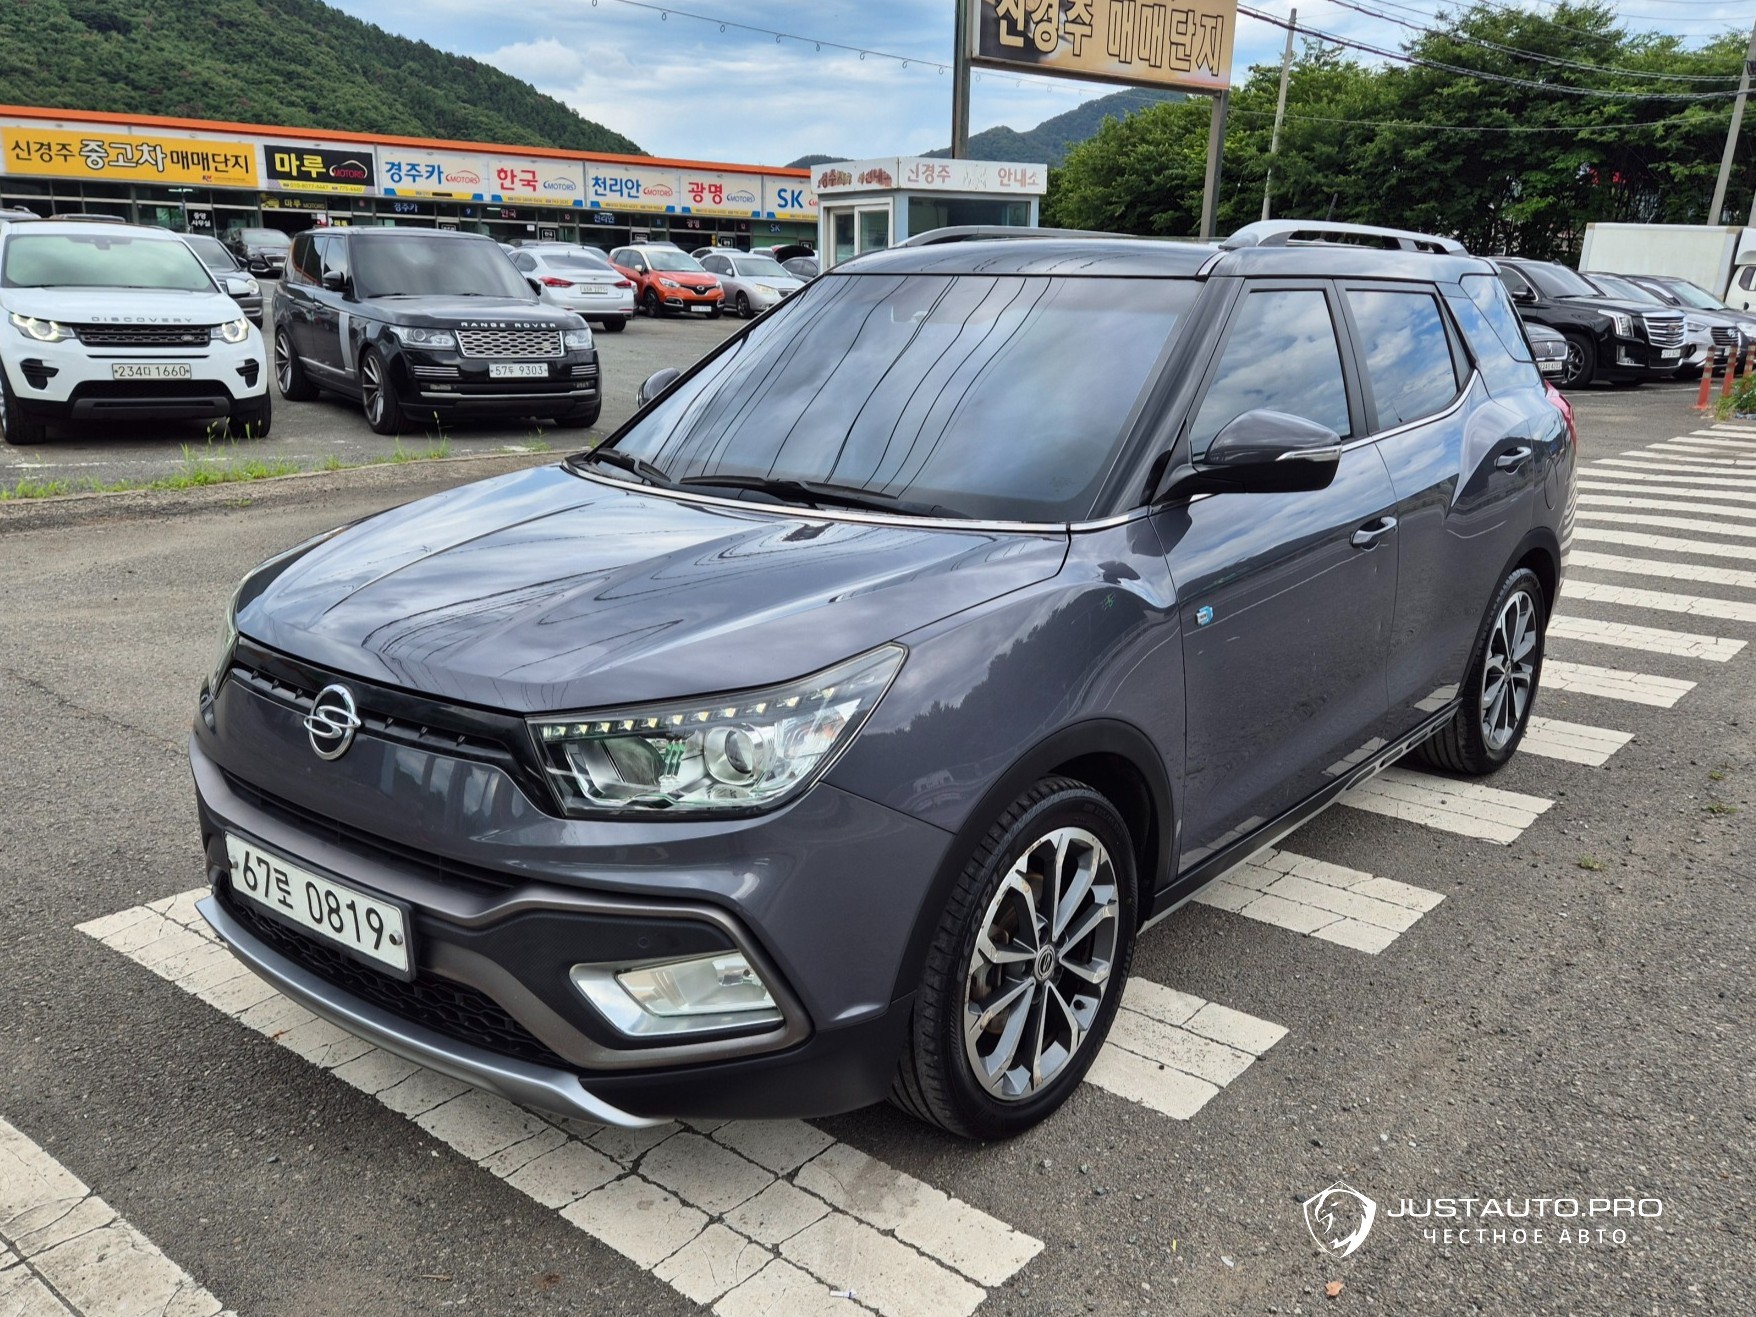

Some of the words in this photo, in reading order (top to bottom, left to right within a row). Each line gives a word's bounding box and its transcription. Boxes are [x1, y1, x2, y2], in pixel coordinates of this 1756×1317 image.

[996, 0, 1093, 57] 신경주
[1106, 0, 1224, 77] 매매단지
[11, 140, 76, 163] 신경주
[79, 138, 167, 173] 중고차
[170, 150, 249, 174] 매매단지
[274, 152, 326, 178] 마루
[333, 168, 364, 178] MOTORS
[385, 161, 444, 185] 경주카
[449, 175, 479, 185] MOTORS
[496, 167, 538, 192] 한국
[547, 182, 575, 191] MOTORS
[592, 176, 641, 198] 천리안
[646, 189, 671, 197] MOTORS
[688, 182, 722, 205] 광명
[730, 194, 754, 203] MOTORS
[777, 188, 804, 209] SK
[770, 223, 780, 233] SK
[156, 366, 187, 378] 1660
[518, 365, 543, 376] 9303
[242, 850, 294, 910] 67로
[305, 880, 385, 951] 0819
